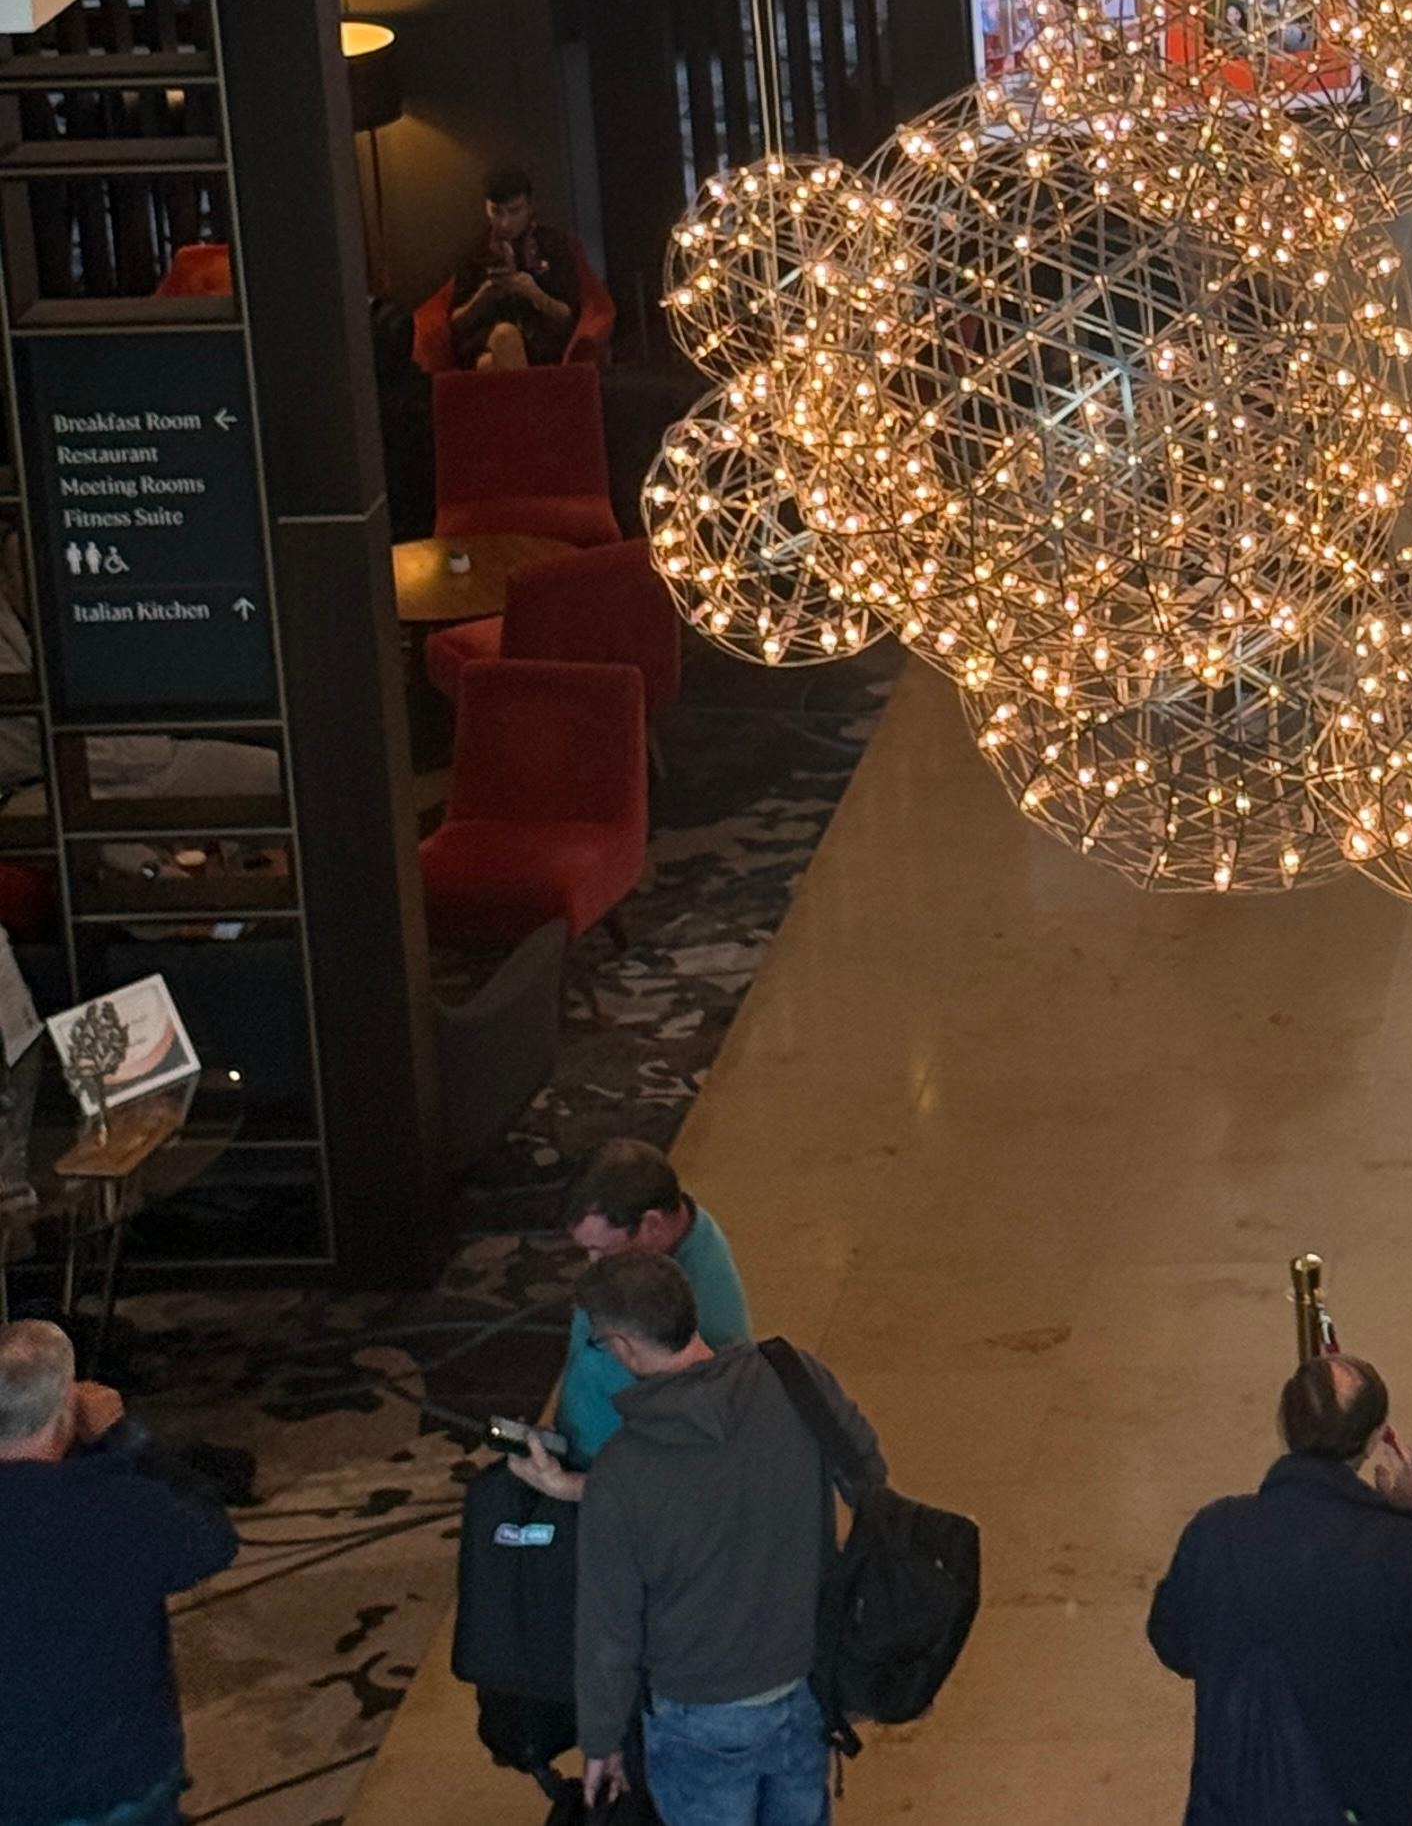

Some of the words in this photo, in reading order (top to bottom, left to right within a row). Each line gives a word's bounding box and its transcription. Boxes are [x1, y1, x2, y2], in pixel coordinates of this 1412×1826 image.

[53, 412, 142, 433] Breakfast
[145, 411, 201, 431] Room
[56, 445, 159, 465] Restaurant
[60, 475, 138, 498] Meeting
[139, 474, 206, 494] Rooms
[63, 507, 132, 529] Fitness
[133, 505, 184, 527] Suite
[73, 601, 134, 623] Italian
[136, 600, 211, 621] Kitchen
